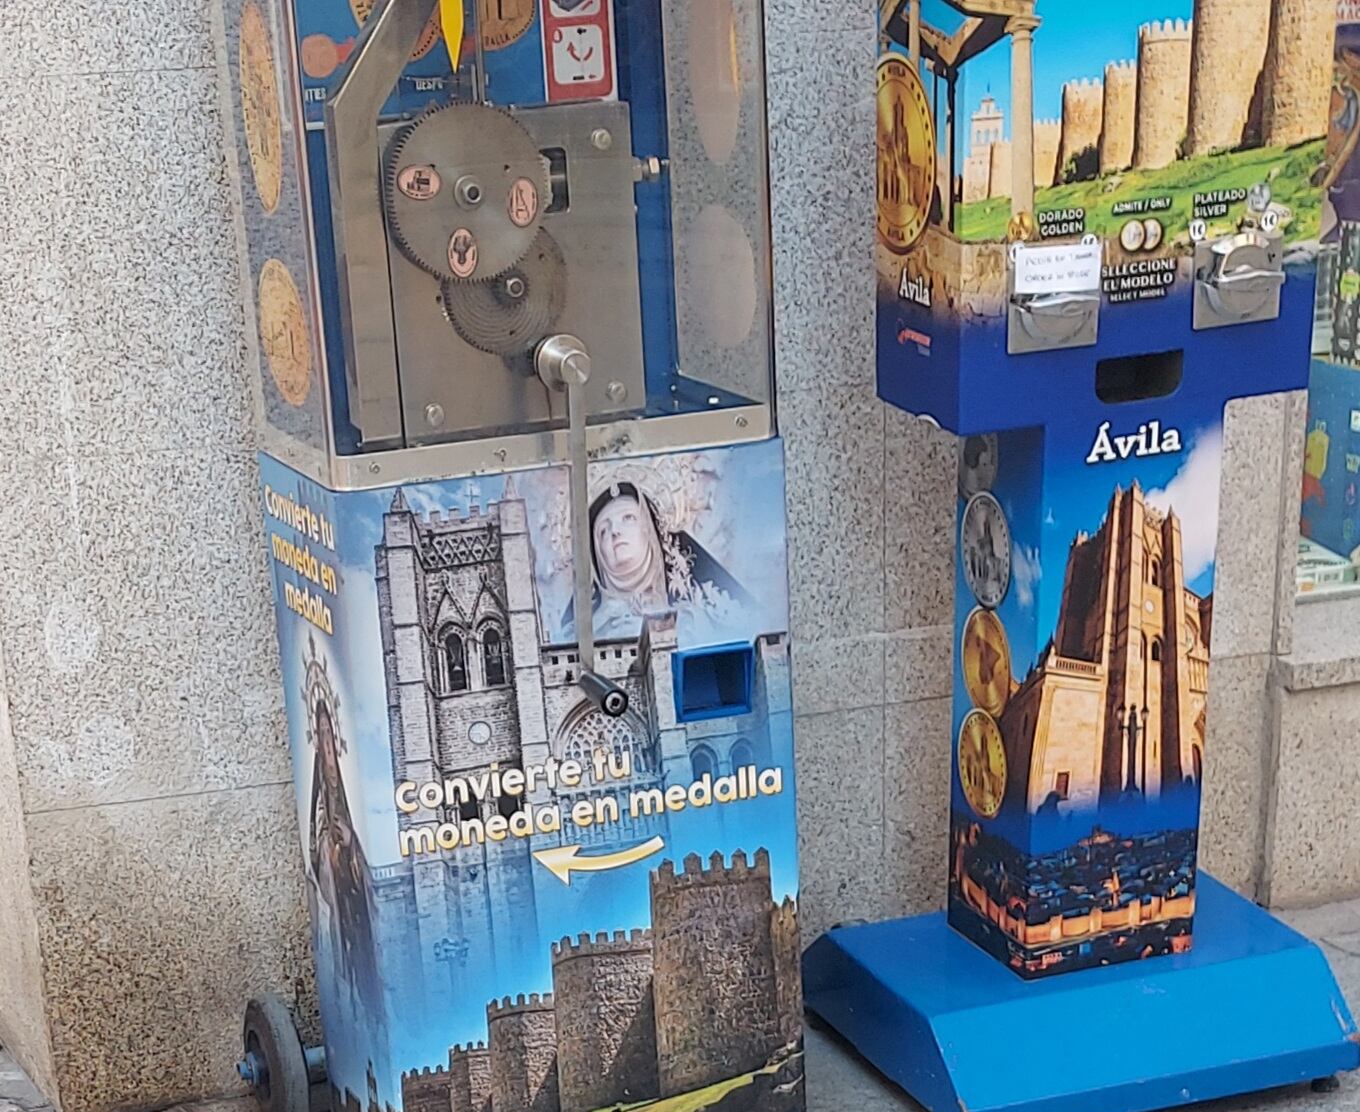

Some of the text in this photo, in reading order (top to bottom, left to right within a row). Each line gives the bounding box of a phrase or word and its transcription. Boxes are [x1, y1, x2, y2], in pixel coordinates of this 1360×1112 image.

[1039, 207, 1084, 223] DORADO
[1194, 188, 1246, 205] PLATEADO
[899, 266, 932, 307] Ávila
[1101, 258, 1177, 278] SELECCIONE
[1103, 272, 1174, 292] EL MODELO
[1086, 420, 1182, 464] Ávila
[319, 512, 336, 551] tu
[271, 532, 337, 595] moneda en
[284, 580, 334, 635] medalla
[593, 747, 631, 781] tu
[399, 764, 783, 857] moneda en medalla
